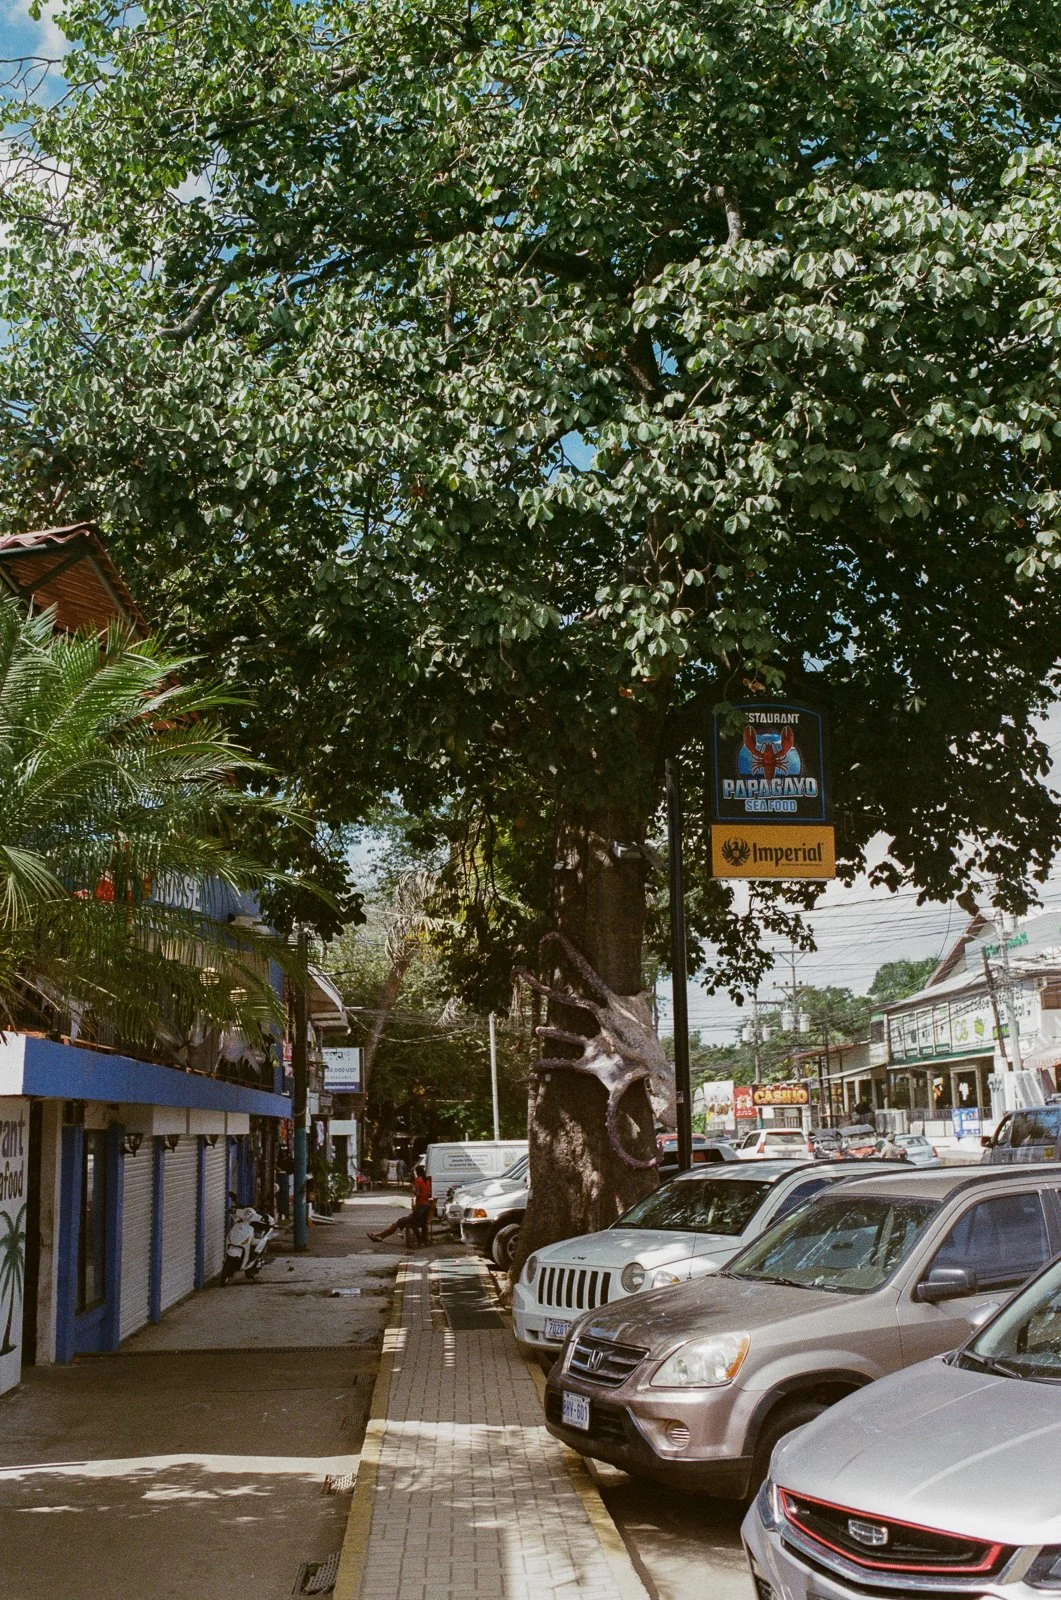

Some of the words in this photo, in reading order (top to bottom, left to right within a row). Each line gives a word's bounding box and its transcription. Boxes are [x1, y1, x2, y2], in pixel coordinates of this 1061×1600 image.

[745, 712, 800, 724] STAURANT
[722, 777, 818, 799] PAPAGAYO
[753, 843, 823, 867] Imperial
[753, 1089, 808, 1105] CASINO
